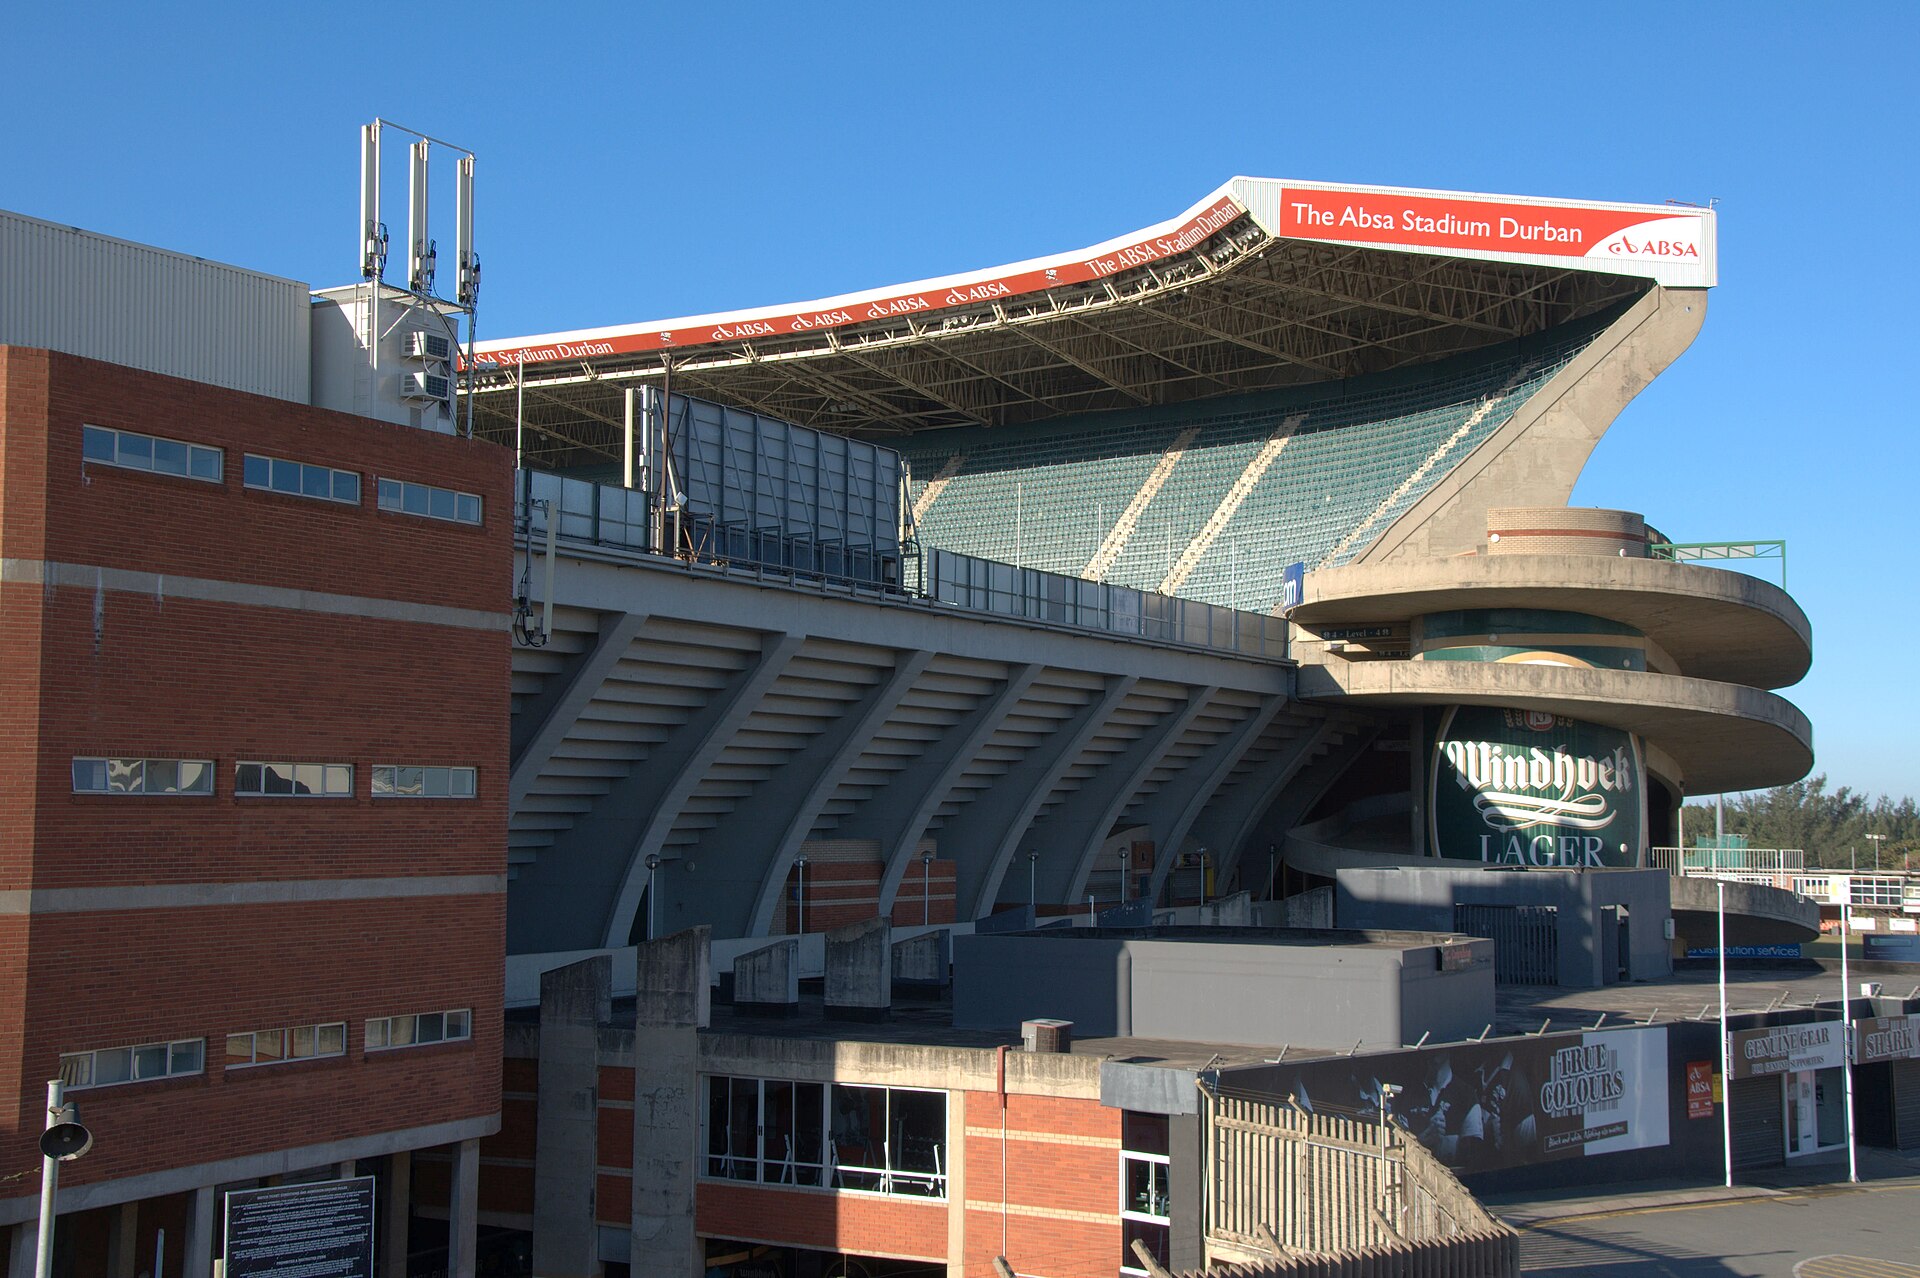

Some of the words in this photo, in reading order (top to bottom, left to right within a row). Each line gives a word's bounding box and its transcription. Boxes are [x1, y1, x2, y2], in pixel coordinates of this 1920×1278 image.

[1291, 203, 1334, 227] The
[1339, 205, 1395, 231] Absa
[1402, 209, 1490, 238] Stadium
[1499, 216, 1582, 244] Durban
[1085, 258, 1117, 277] The
[1118, 243, 1160, 268] ABSA
[1158, 224, 1205, 257] Stadium
[1198, 202, 1239, 234] Durban
[1641, 239, 1699, 258] ABSA
[890, 296, 930, 314] ABSA
[969, 282, 1011, 301] ABSA
[735, 321, 775, 337] ABSA
[815, 310, 853, 327] ABSA
[498, 345, 557, 365] Stadium
[558, 340, 614, 359] Durban
[1439, 740, 1632, 796] Windhoek
[1479, 834, 1606, 868] LAGER
[1757, 945, 1799, 956] services
[1745, 1033, 1797, 1059] GENUINE
[1800, 1027, 1830, 1048] GEAR
[1866, 1028, 1913, 1057] SHARK
[1557, 1043, 1606, 1078] TRUE
[1541, 1070, 1624, 1114] COLOURS
[1689, 1080, 1711, 1094] ABSA
